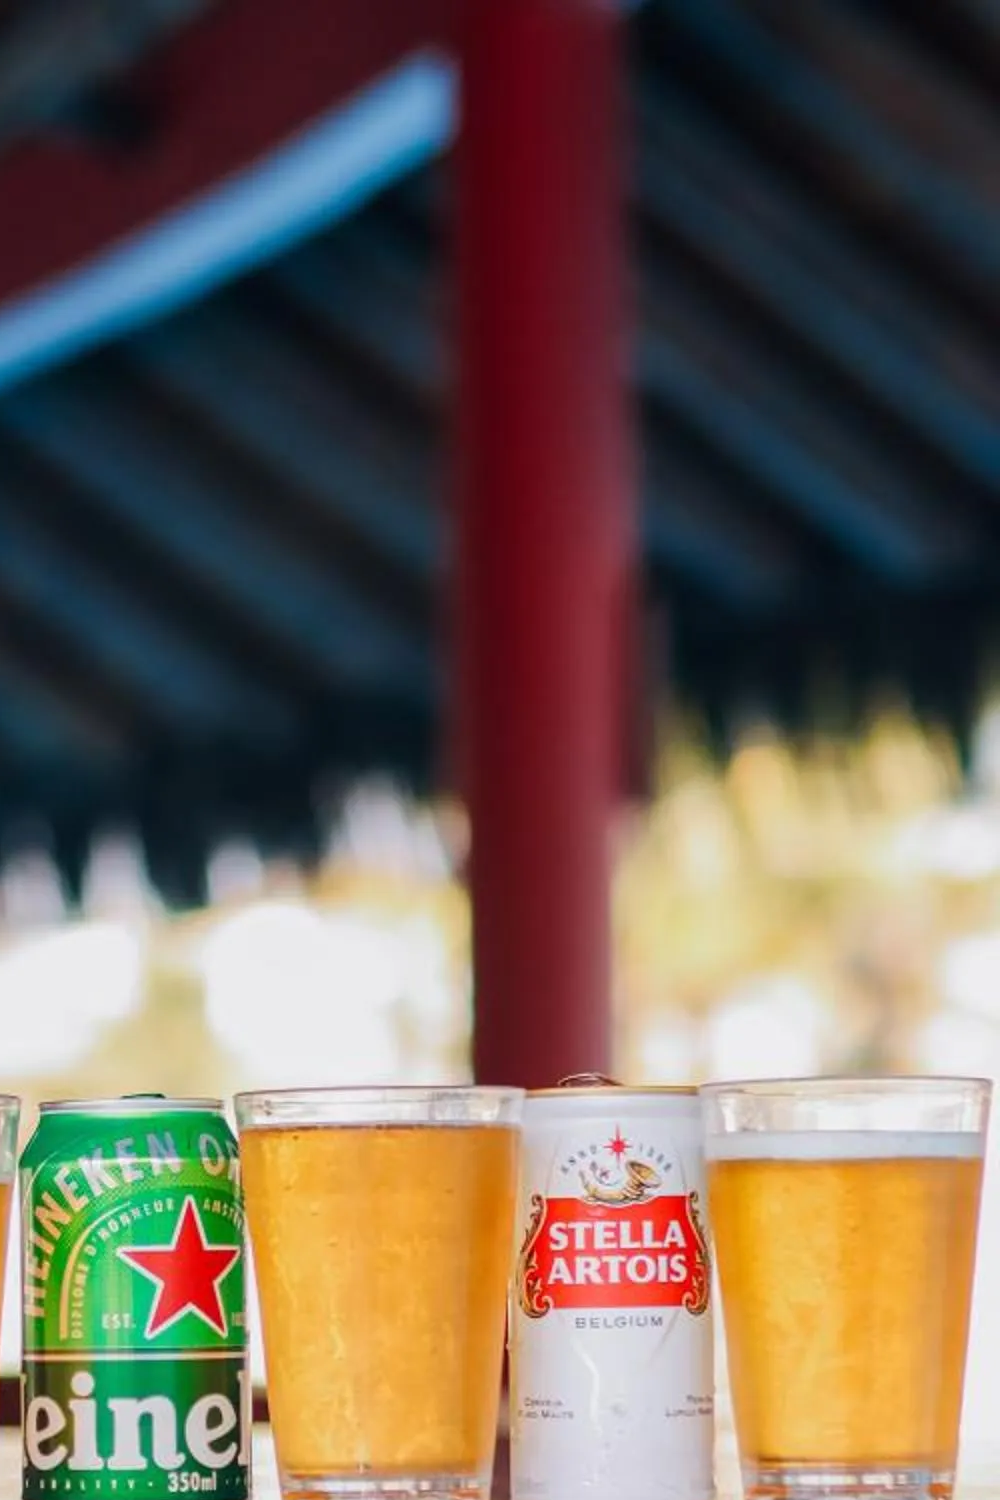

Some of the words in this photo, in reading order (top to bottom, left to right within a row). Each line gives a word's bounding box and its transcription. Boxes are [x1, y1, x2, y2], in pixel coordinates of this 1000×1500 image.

[23, 1131, 183, 1318] HEINEKEN
[549, 1219, 687, 1251] STELLA
[547, 1253, 689, 1286] ARTOIS
[101, 1312, 137, 1330] EST.
[574, 1315, 664, 1330] BELGIUM
[167, 1471, 218, 1493] 350ml
